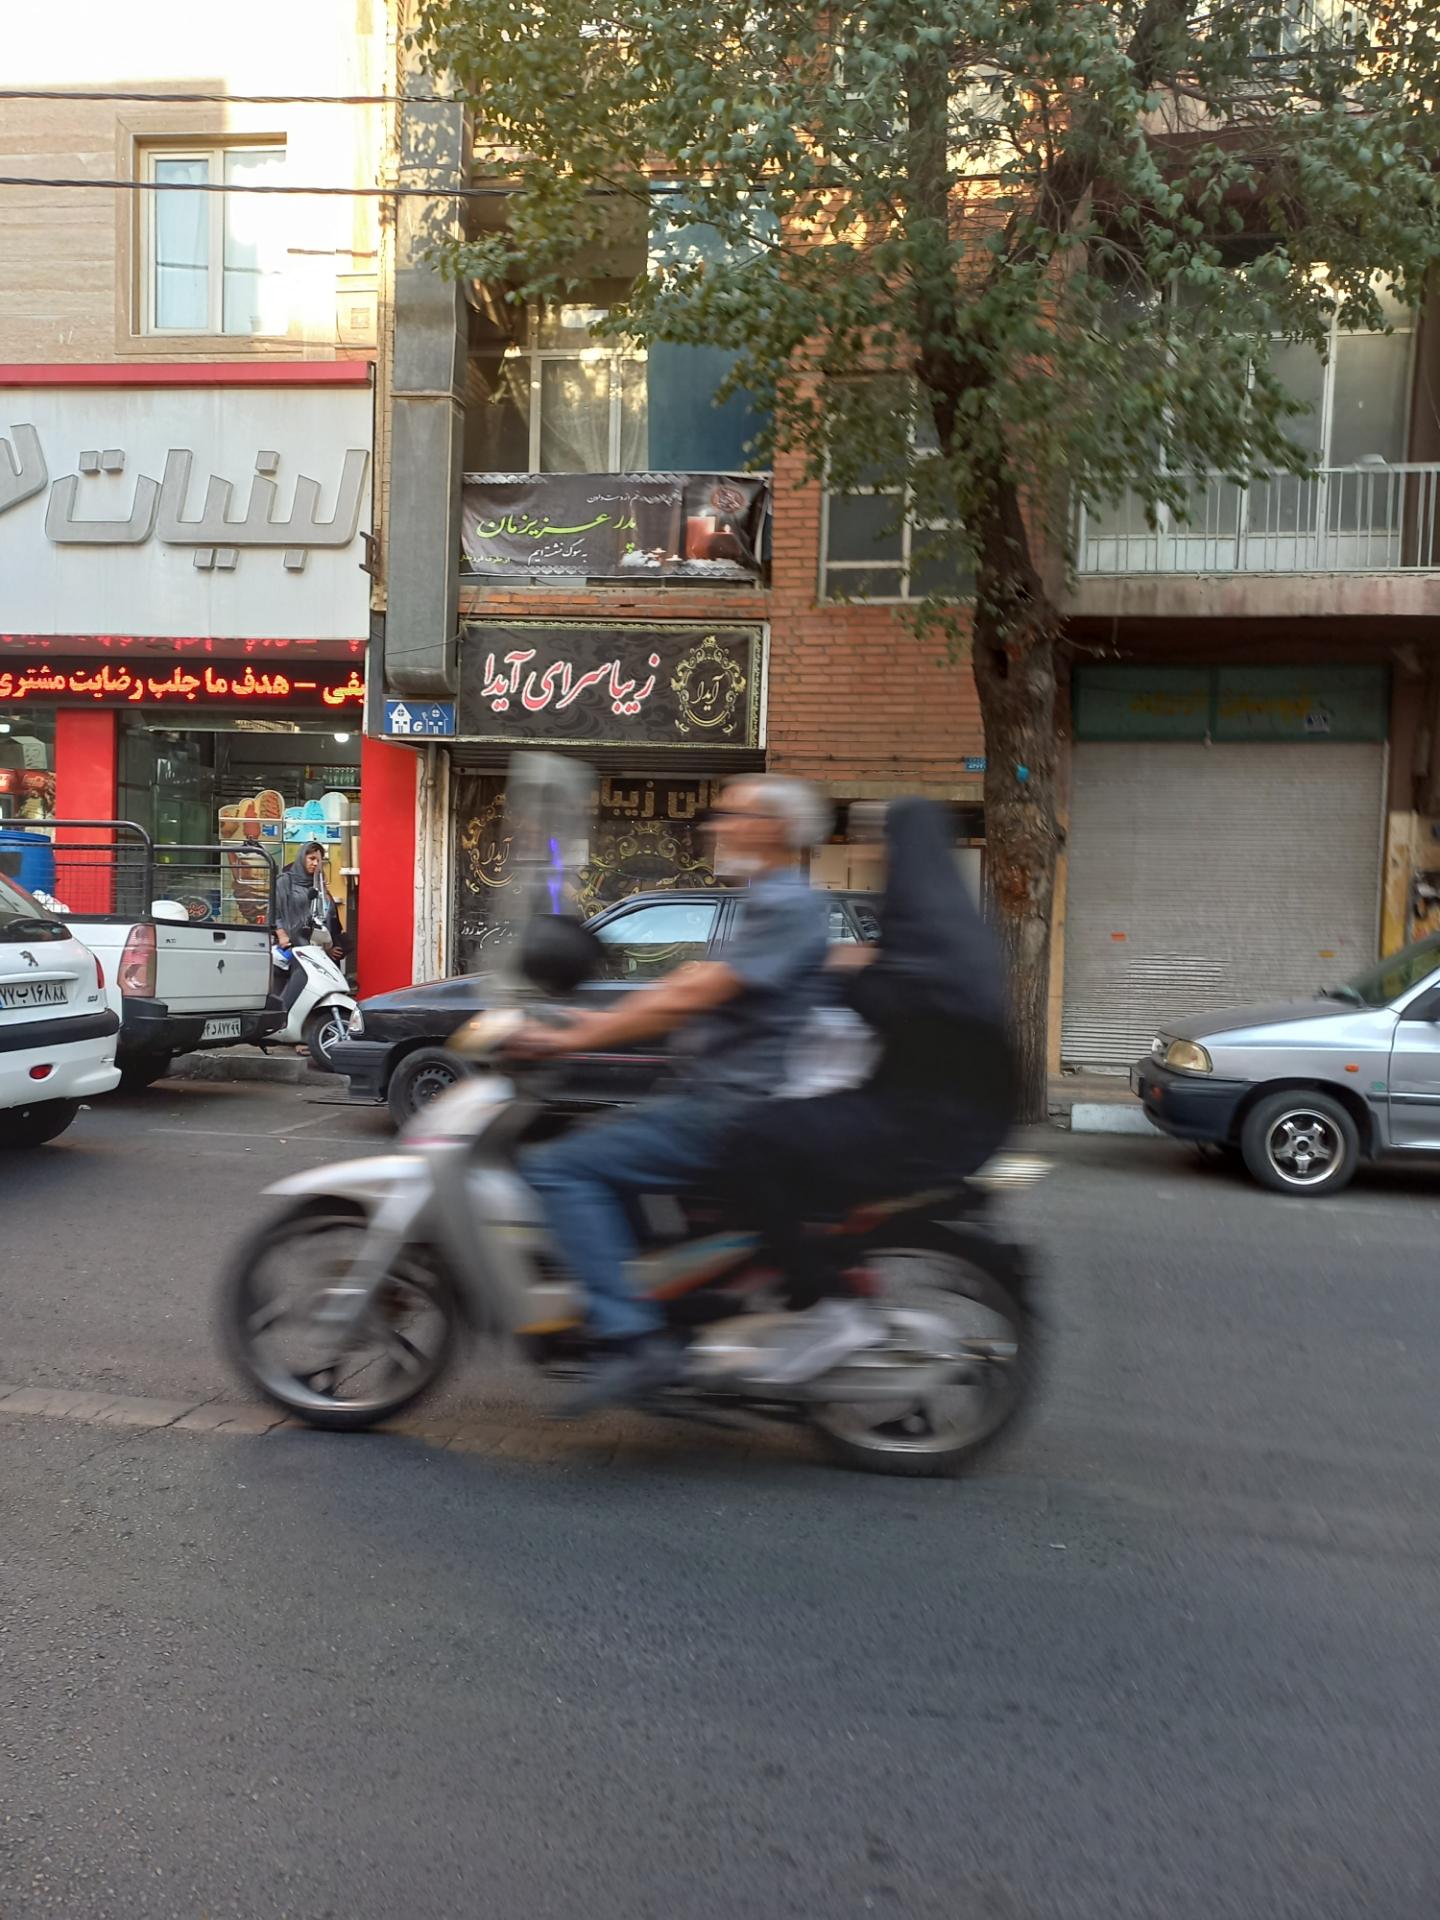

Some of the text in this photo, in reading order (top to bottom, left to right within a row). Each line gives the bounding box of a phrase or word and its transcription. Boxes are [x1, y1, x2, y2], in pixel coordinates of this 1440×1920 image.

[45, 448, 370, 571] لبنیات
[0, 665, 64, 698] مشتری
[69, 665, 144, 700] رضایت
[147, 666, 200, 700] جلب
[205, 667, 228, 694] ما
[231, 666, 290, 696] هدف
[481, 649, 537, 712] آیدا
[689, 671, 728, 711] آیدا
